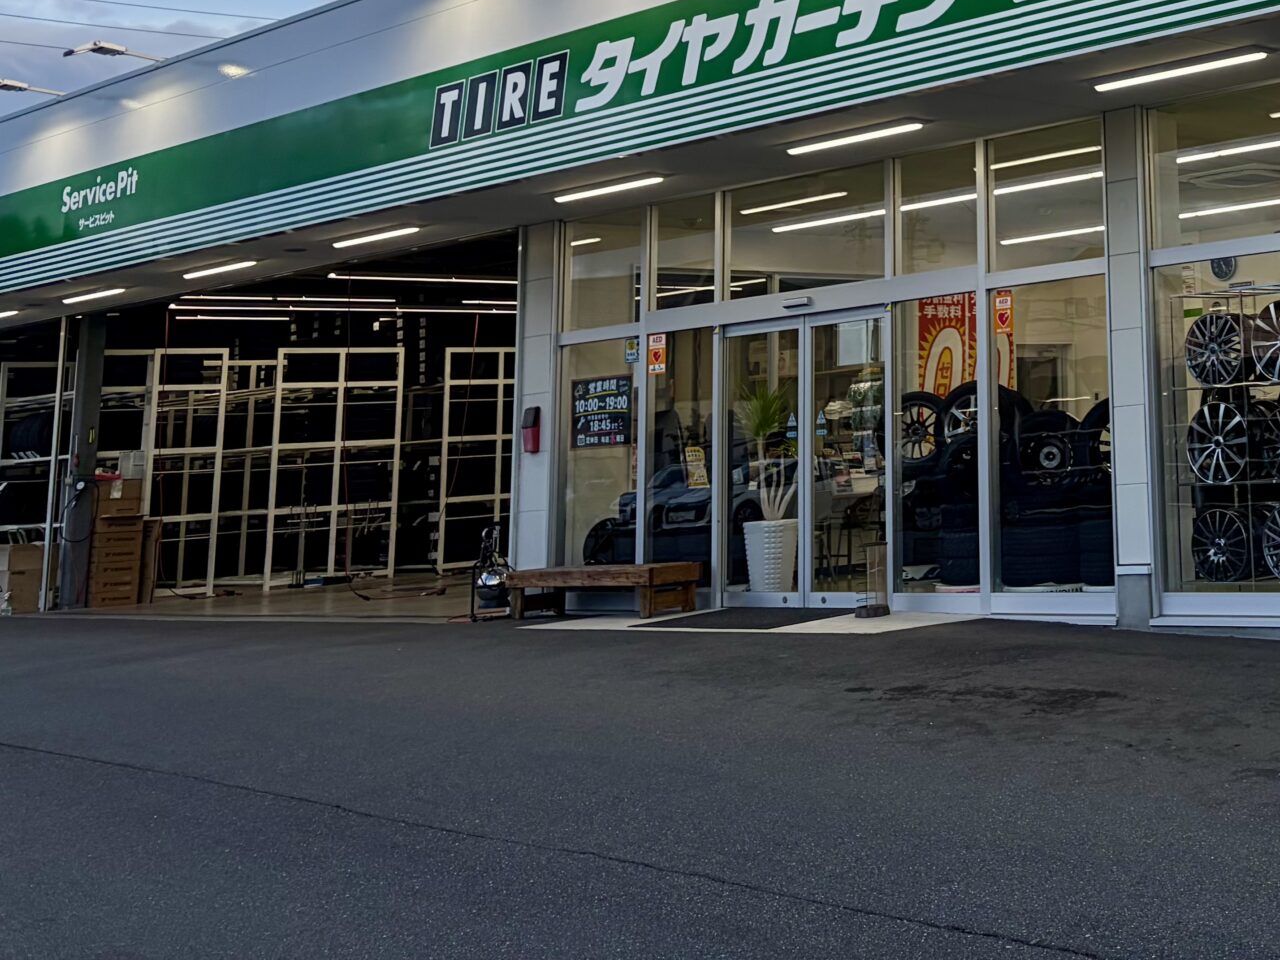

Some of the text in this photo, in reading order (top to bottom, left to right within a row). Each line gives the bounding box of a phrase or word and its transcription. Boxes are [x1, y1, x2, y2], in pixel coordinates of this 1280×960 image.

[440, 60, 561, 138] TIRE
[923, 304, 962, 319] 手数料
